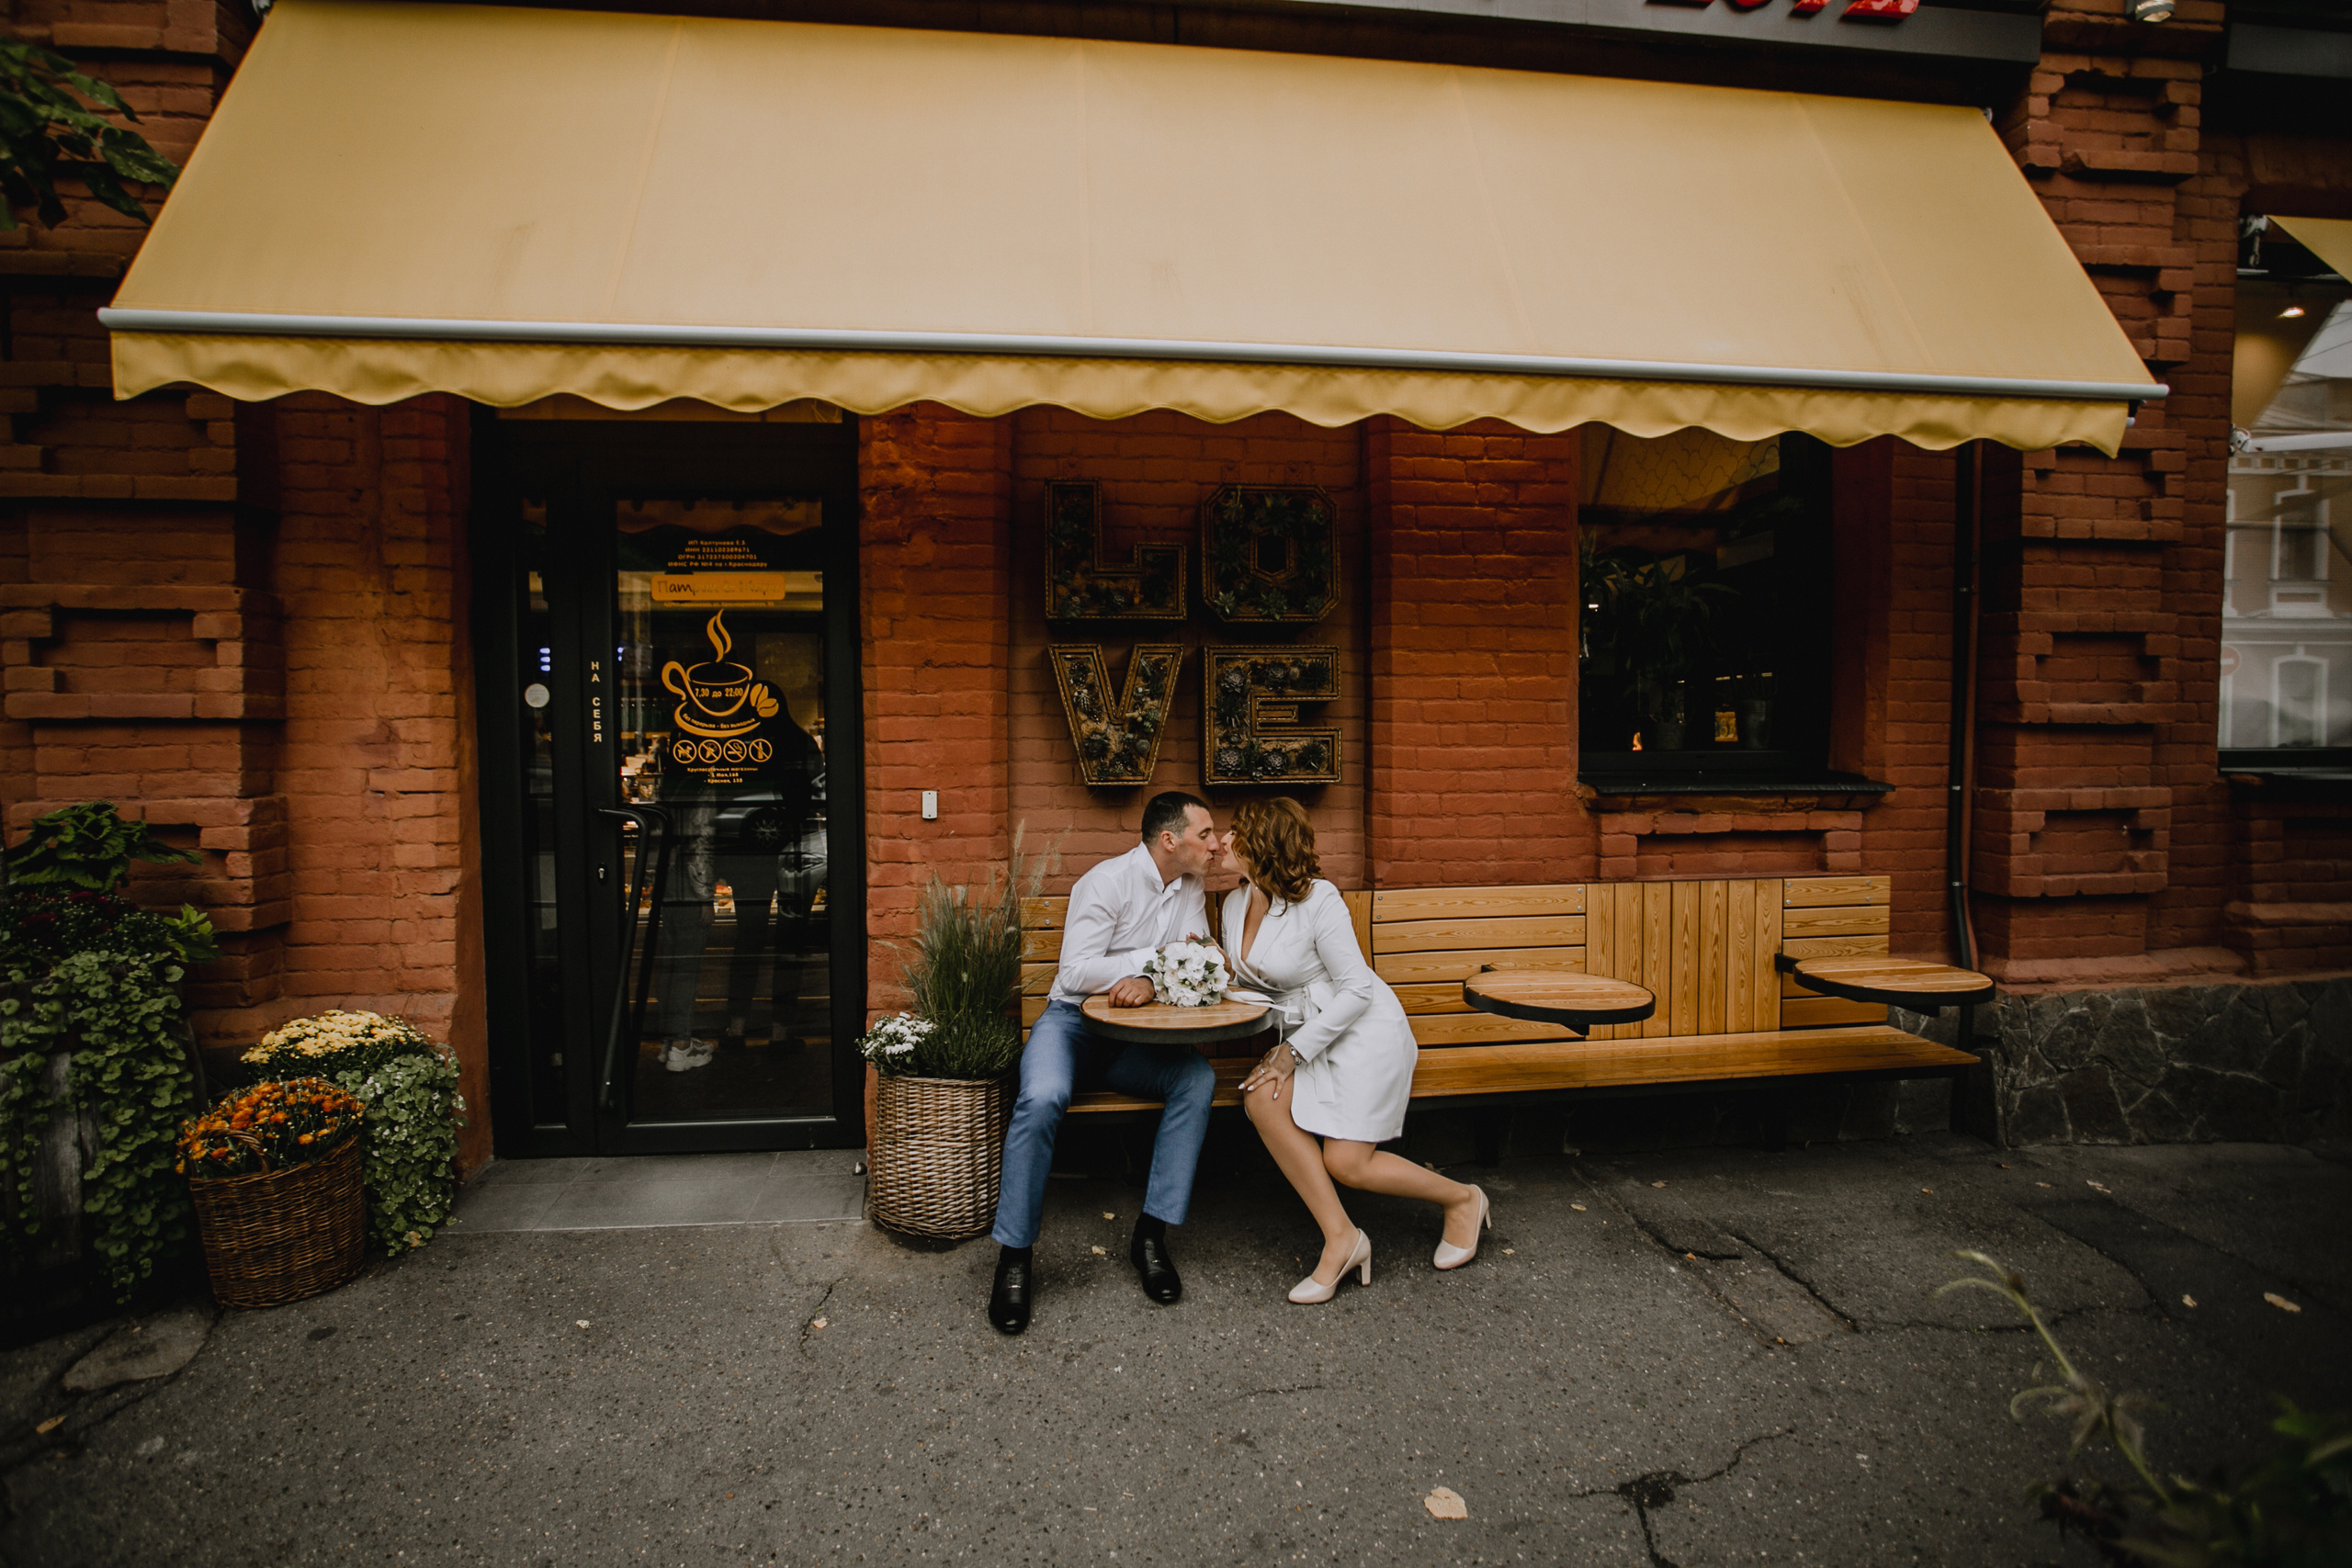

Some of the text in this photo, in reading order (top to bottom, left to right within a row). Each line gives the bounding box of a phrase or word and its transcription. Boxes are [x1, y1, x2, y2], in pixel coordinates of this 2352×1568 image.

[591, 660, 601, 682] НА
[725, 687, 743, 697] 22:00
[592, 697, 603, 743] СЕБЯ
[682, 713, 691, 722] без
